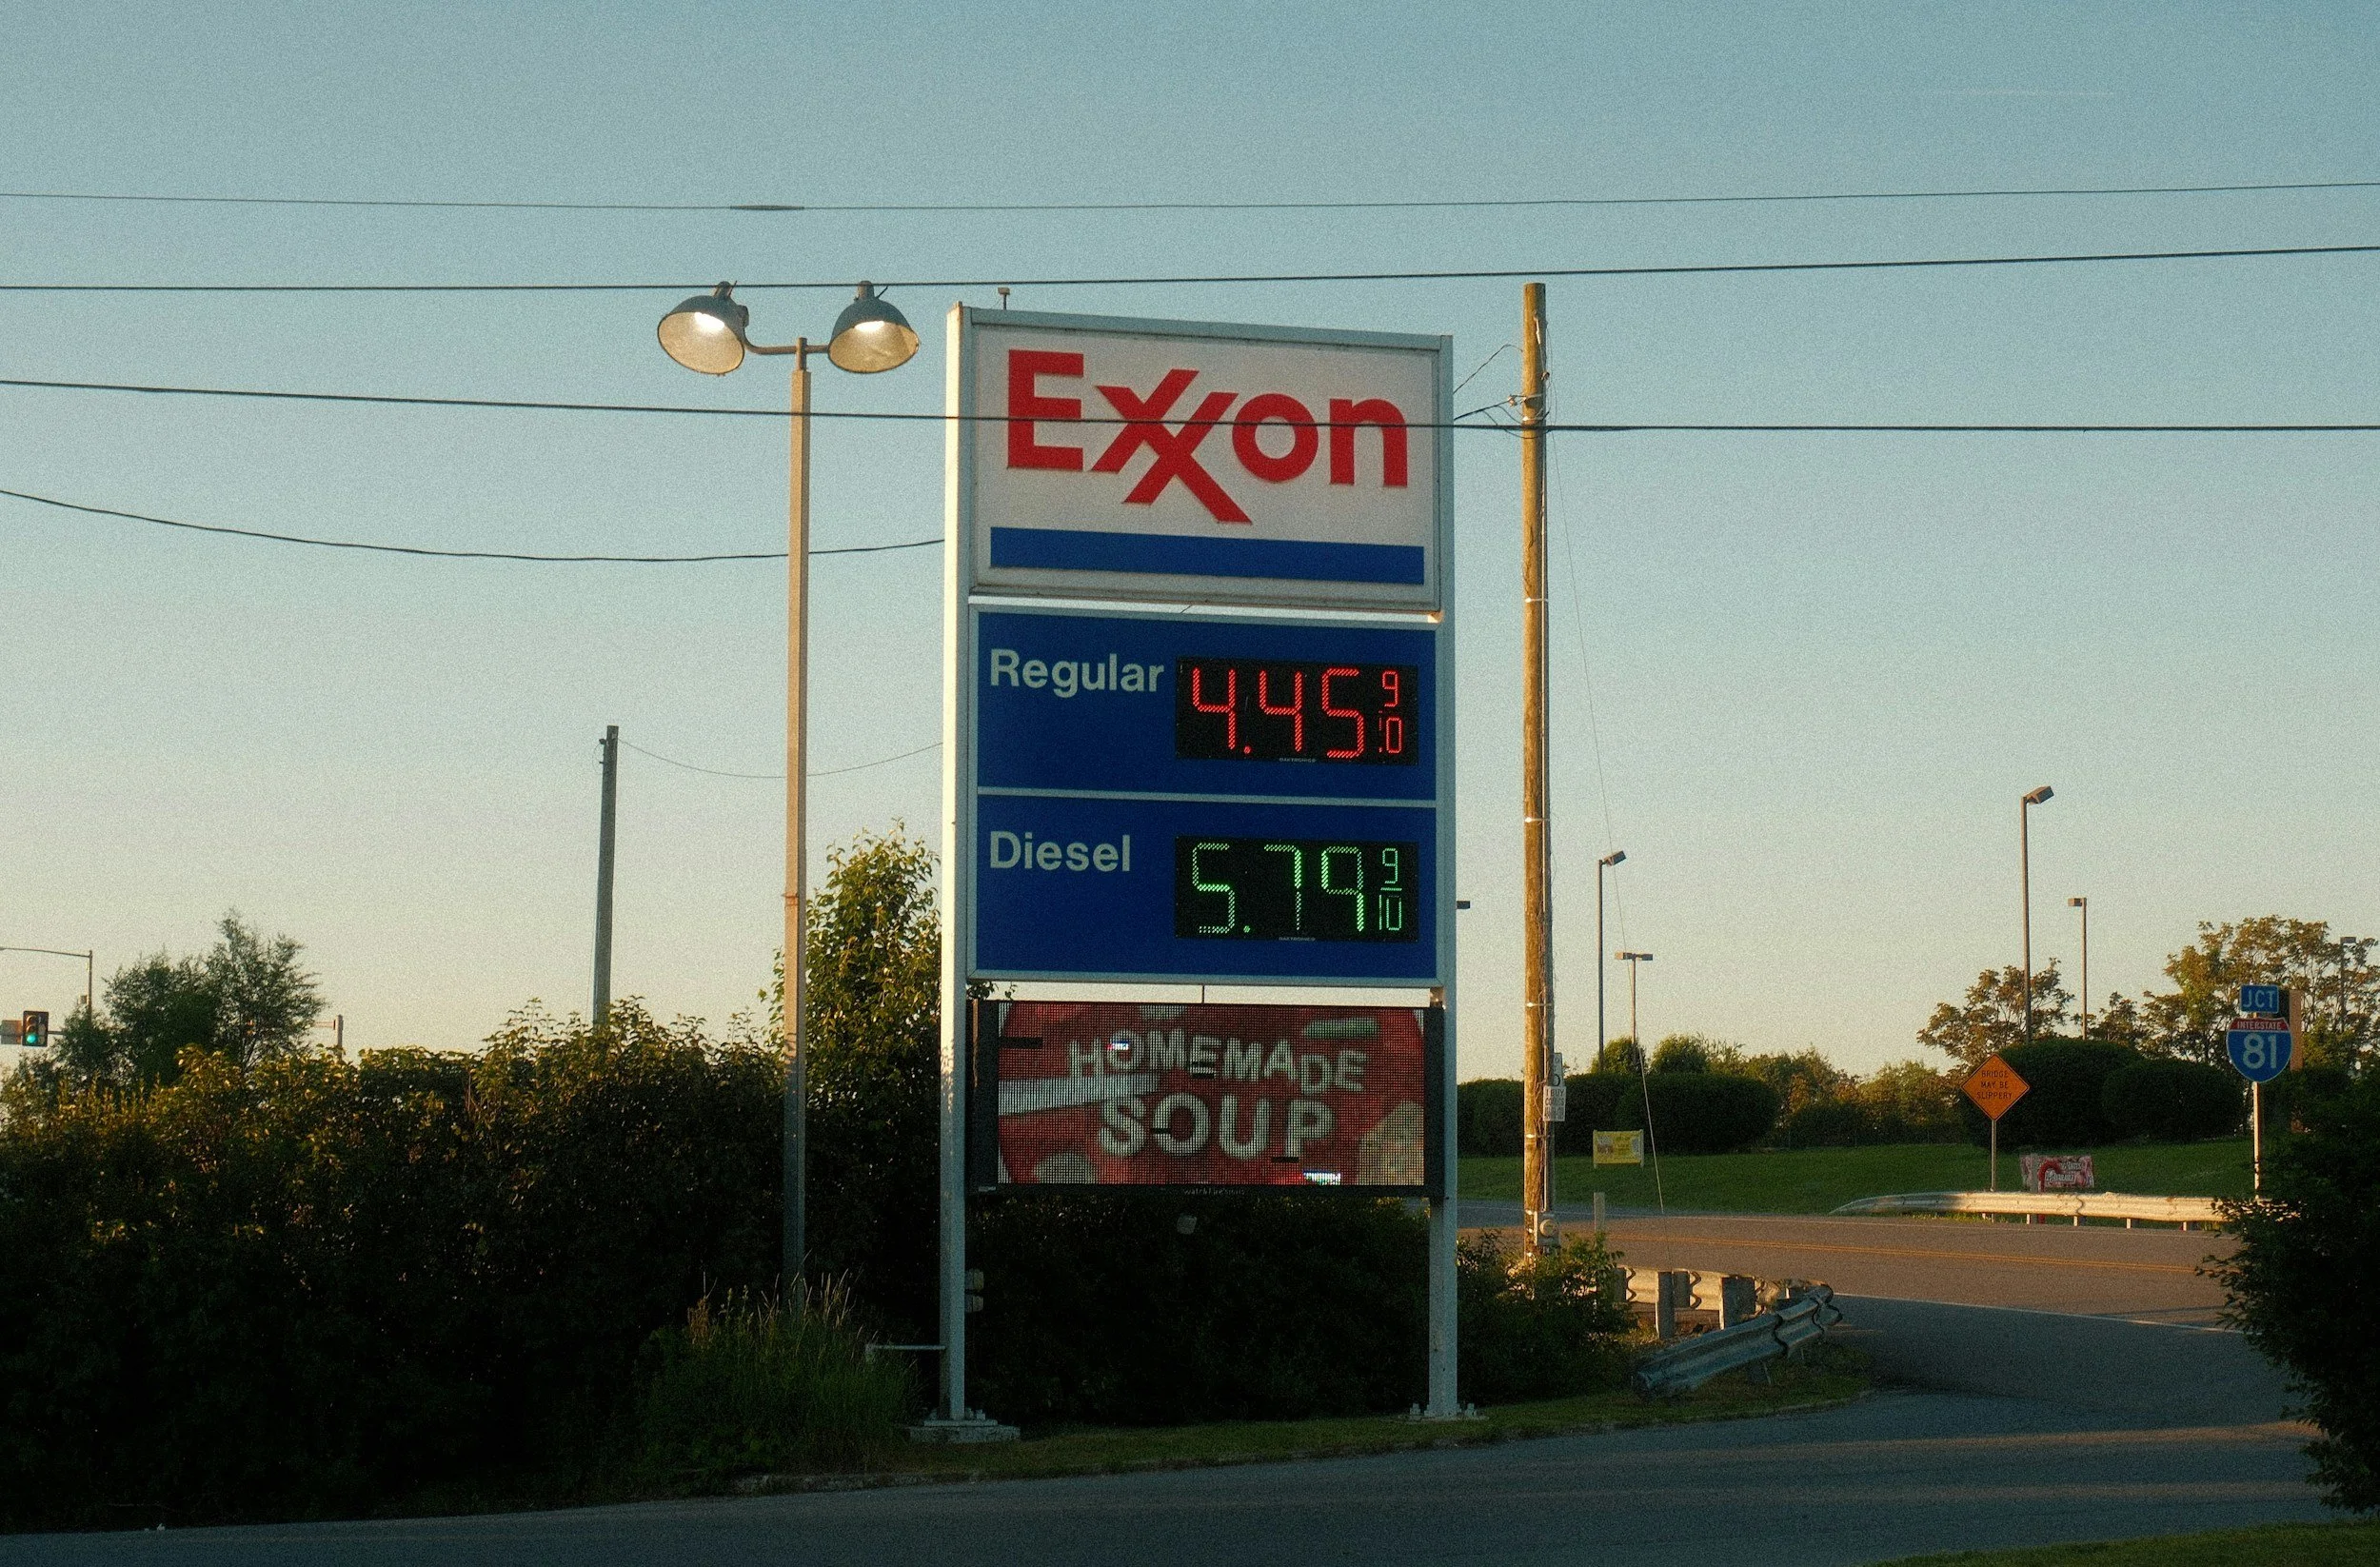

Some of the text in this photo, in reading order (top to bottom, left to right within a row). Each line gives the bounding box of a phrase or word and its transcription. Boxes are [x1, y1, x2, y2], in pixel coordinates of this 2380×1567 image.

[1007, 348, 1408, 525] Exxon
[990, 649, 1163, 698] Regular
[1192, 666, 1365, 760] 4.45
[990, 831, 1131, 873] Diesel
[1192, 842, 1365, 934] 5.79
[2237, 1021, 2282, 1030] INTERSTATE
[2242, 989, 2274, 1008] JCT
[1067, 1028, 1370, 1095] HOMEMADE
[2242, 1033, 2278, 1070] 81
[1097, 1092, 1337, 1160] SOUP
